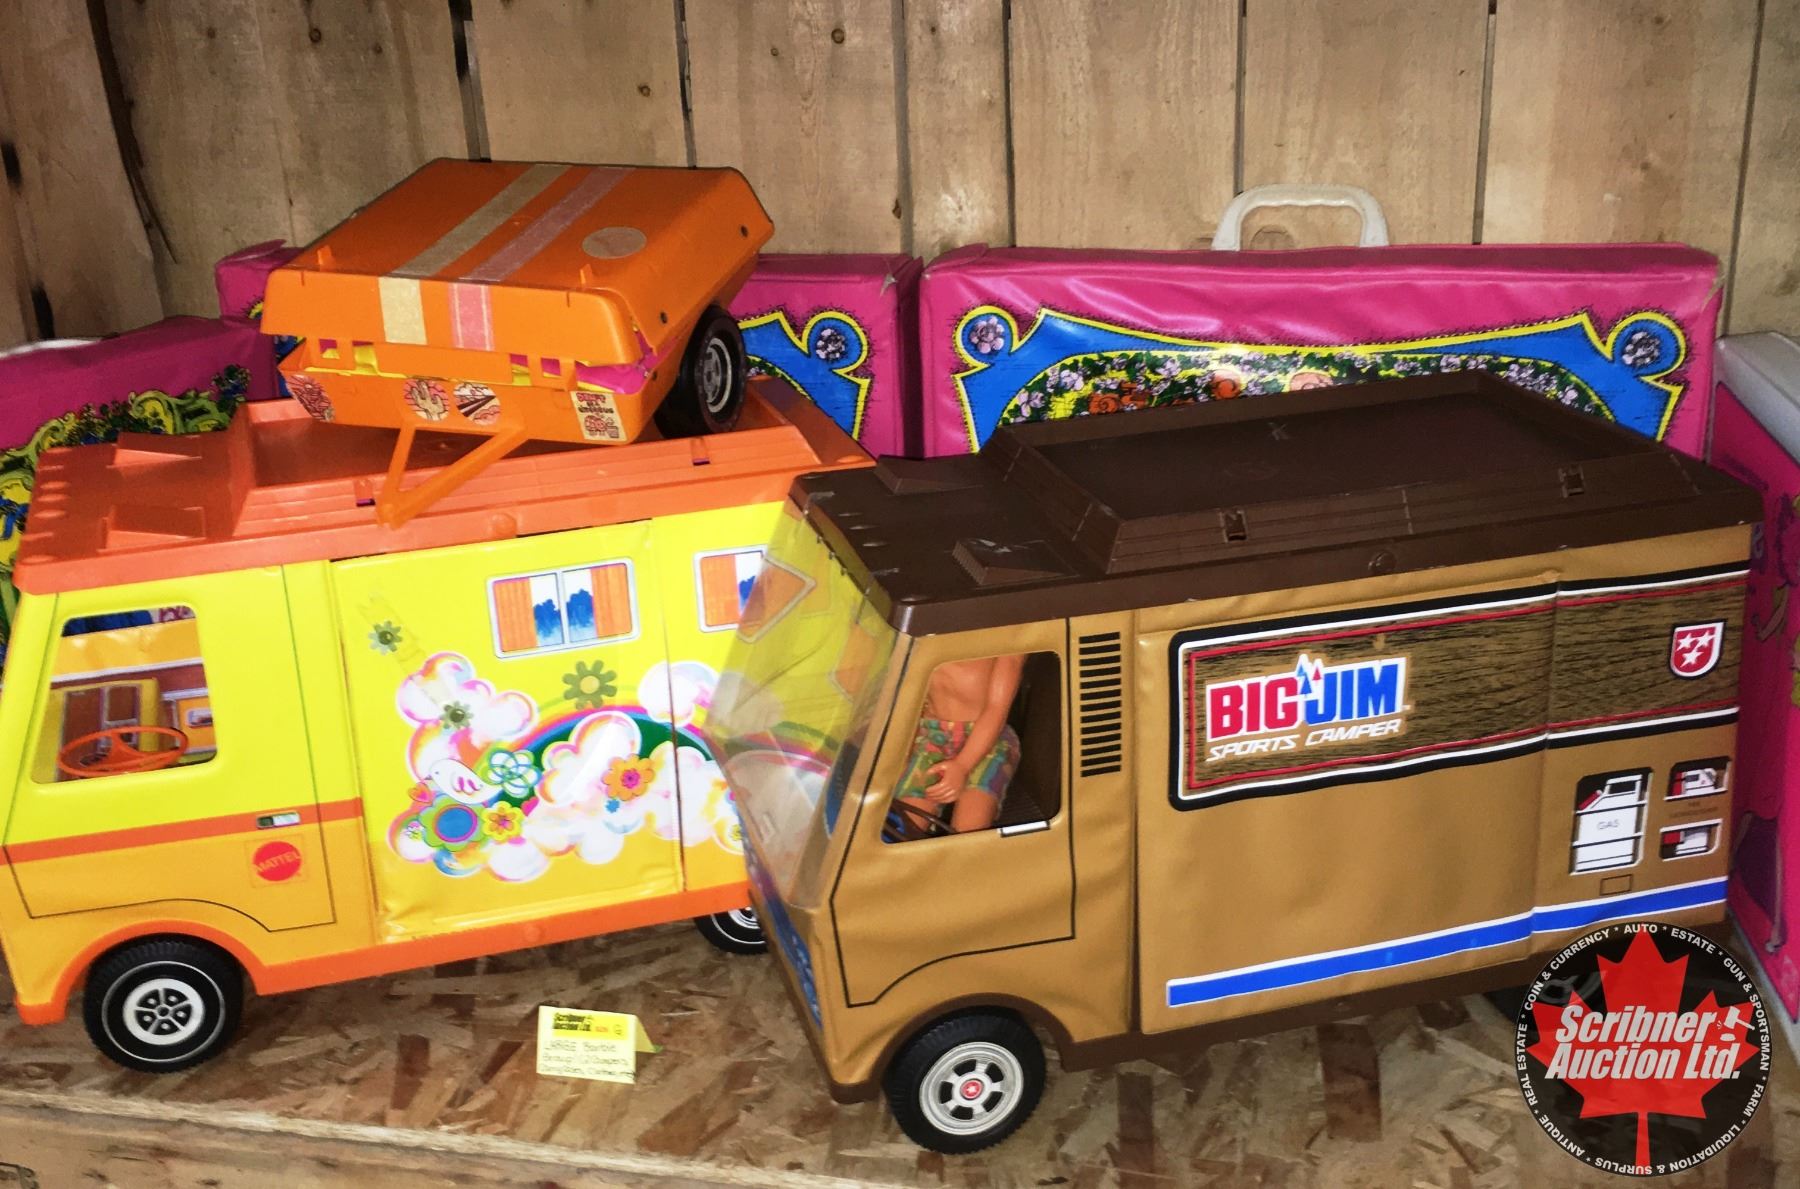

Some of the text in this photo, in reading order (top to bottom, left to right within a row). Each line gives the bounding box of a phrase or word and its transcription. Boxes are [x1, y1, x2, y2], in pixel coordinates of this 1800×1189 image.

[1208, 663, 1400, 740] BIG JIM
[1206, 718, 1402, 762] SPORTS CAMPER
[1597, 819, 1619, 830] GAS
[252, 851, 301, 871] MATTEL
